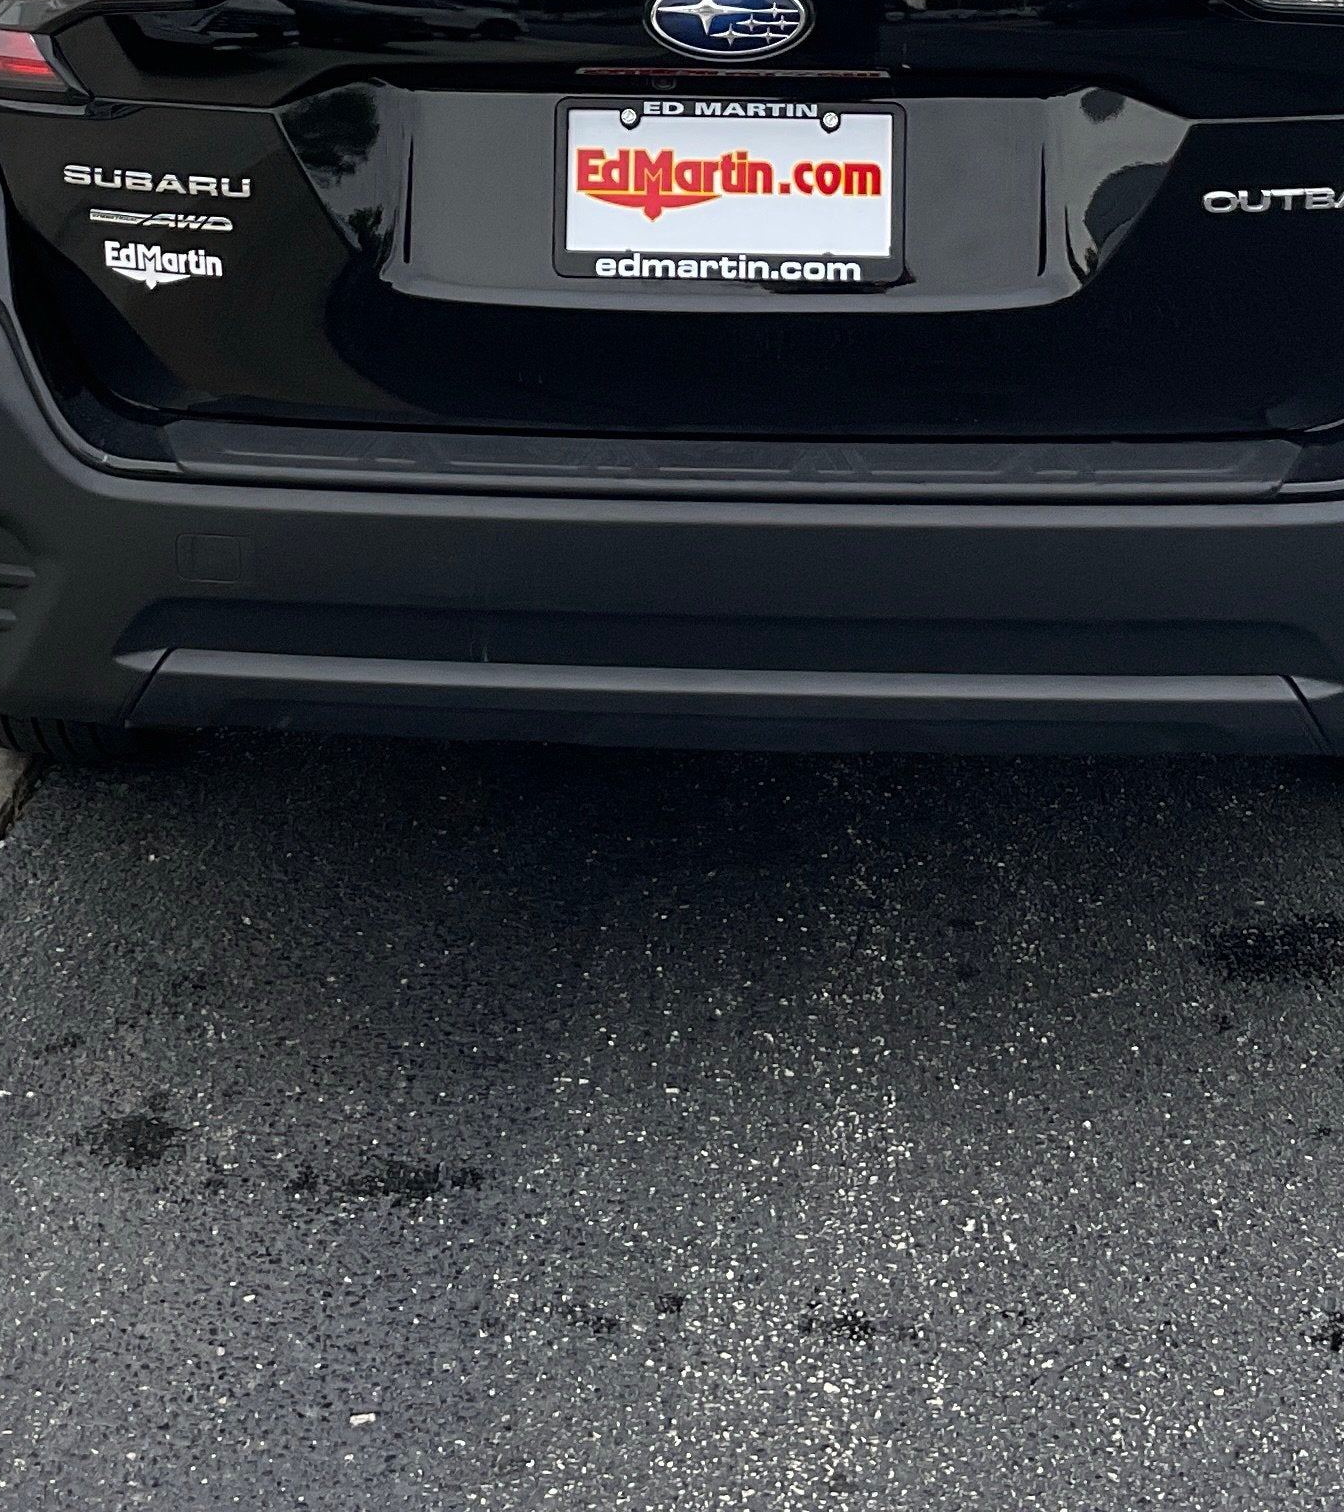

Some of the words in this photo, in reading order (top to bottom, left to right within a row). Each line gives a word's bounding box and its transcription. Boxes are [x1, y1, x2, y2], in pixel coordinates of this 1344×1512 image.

[643, 101, 685, 116] ED
[694, 102, 818, 118] MARTIN
[62, 163, 251, 199] SUBARU
[575, 147, 882, 198] EdMartin.com
[142, 213, 234, 231] AWD
[104, 240, 223, 277] EdMartin
[595, 252, 861, 281] edmartin.com
